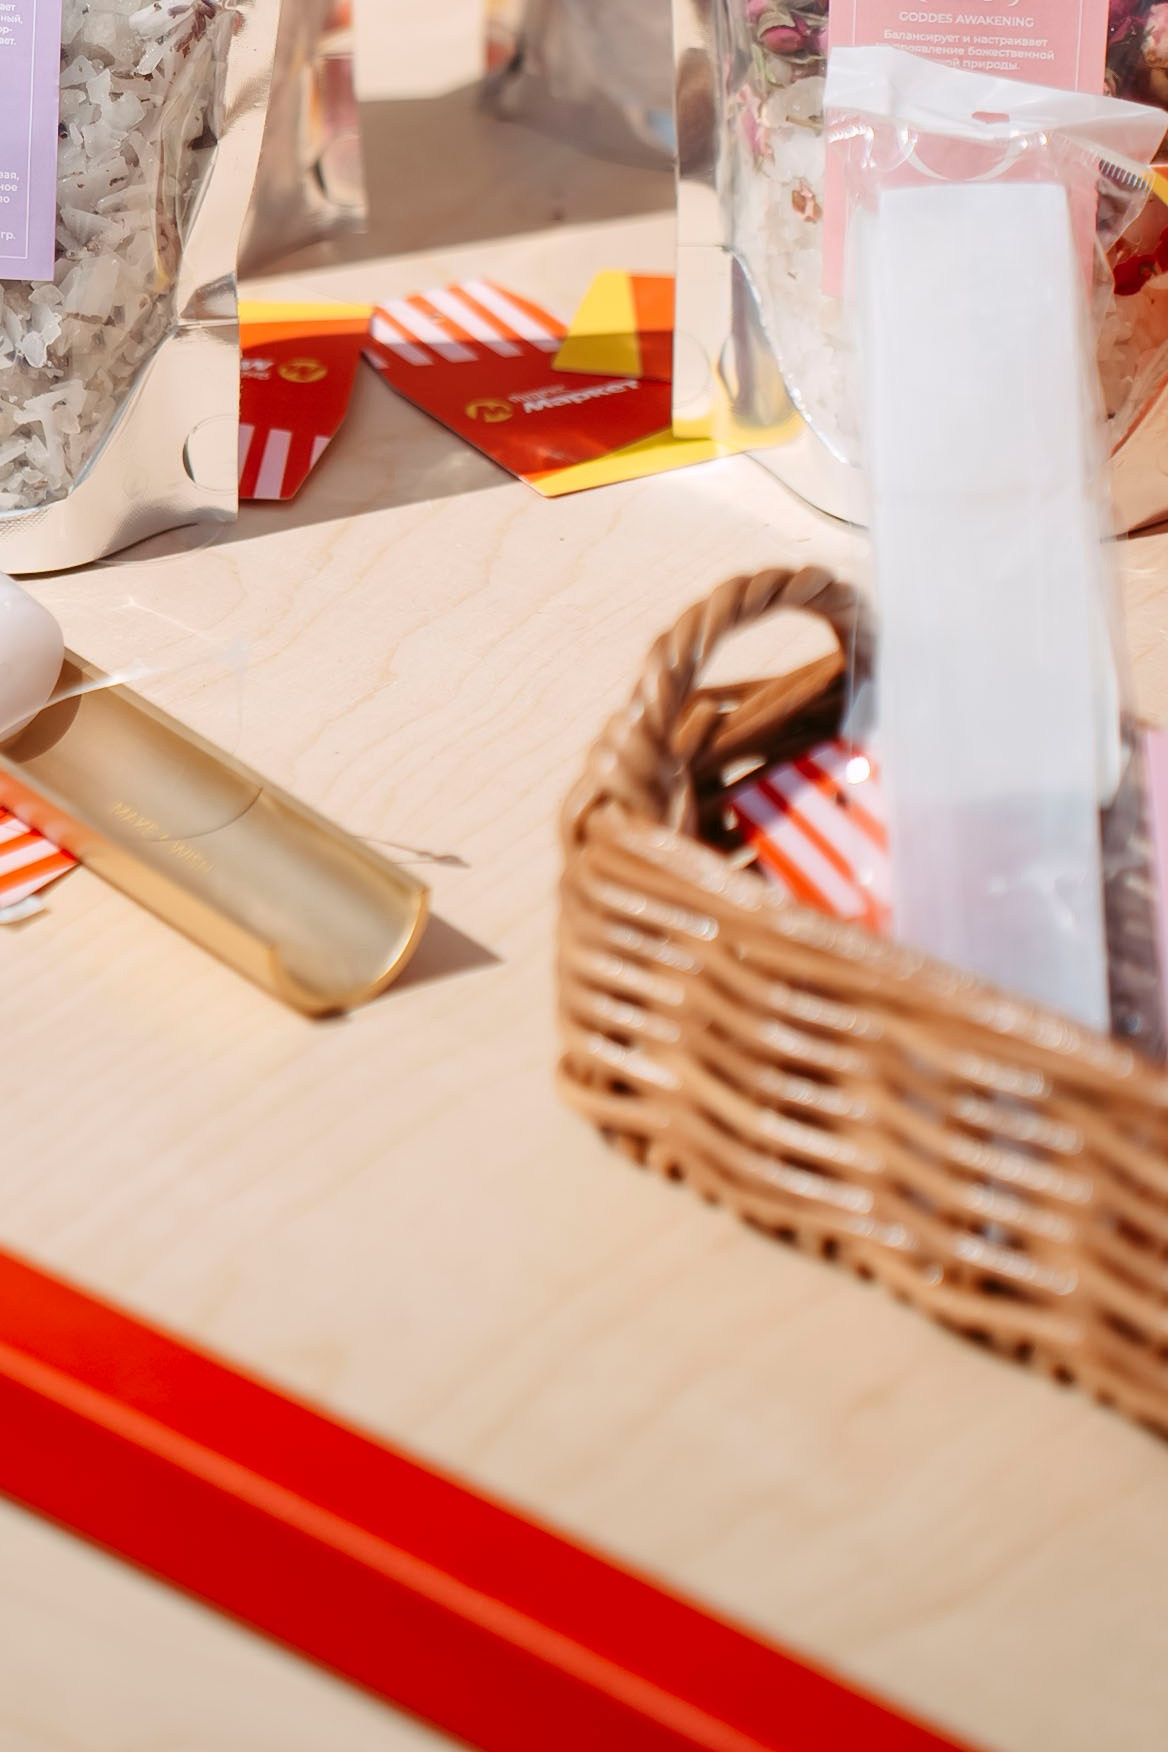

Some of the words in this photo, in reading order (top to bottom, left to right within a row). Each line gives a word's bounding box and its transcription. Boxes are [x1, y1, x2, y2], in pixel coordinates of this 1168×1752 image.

[899, 11, 953, 24] GODDES
[956, 14, 1035, 28] AWAKENING
[883, 29, 960, 44] Балансирует
[962, 35, 971, 44] и
[973, 35, 1049, 47] настраивает
[967, 46, 1055, 61] божественной
